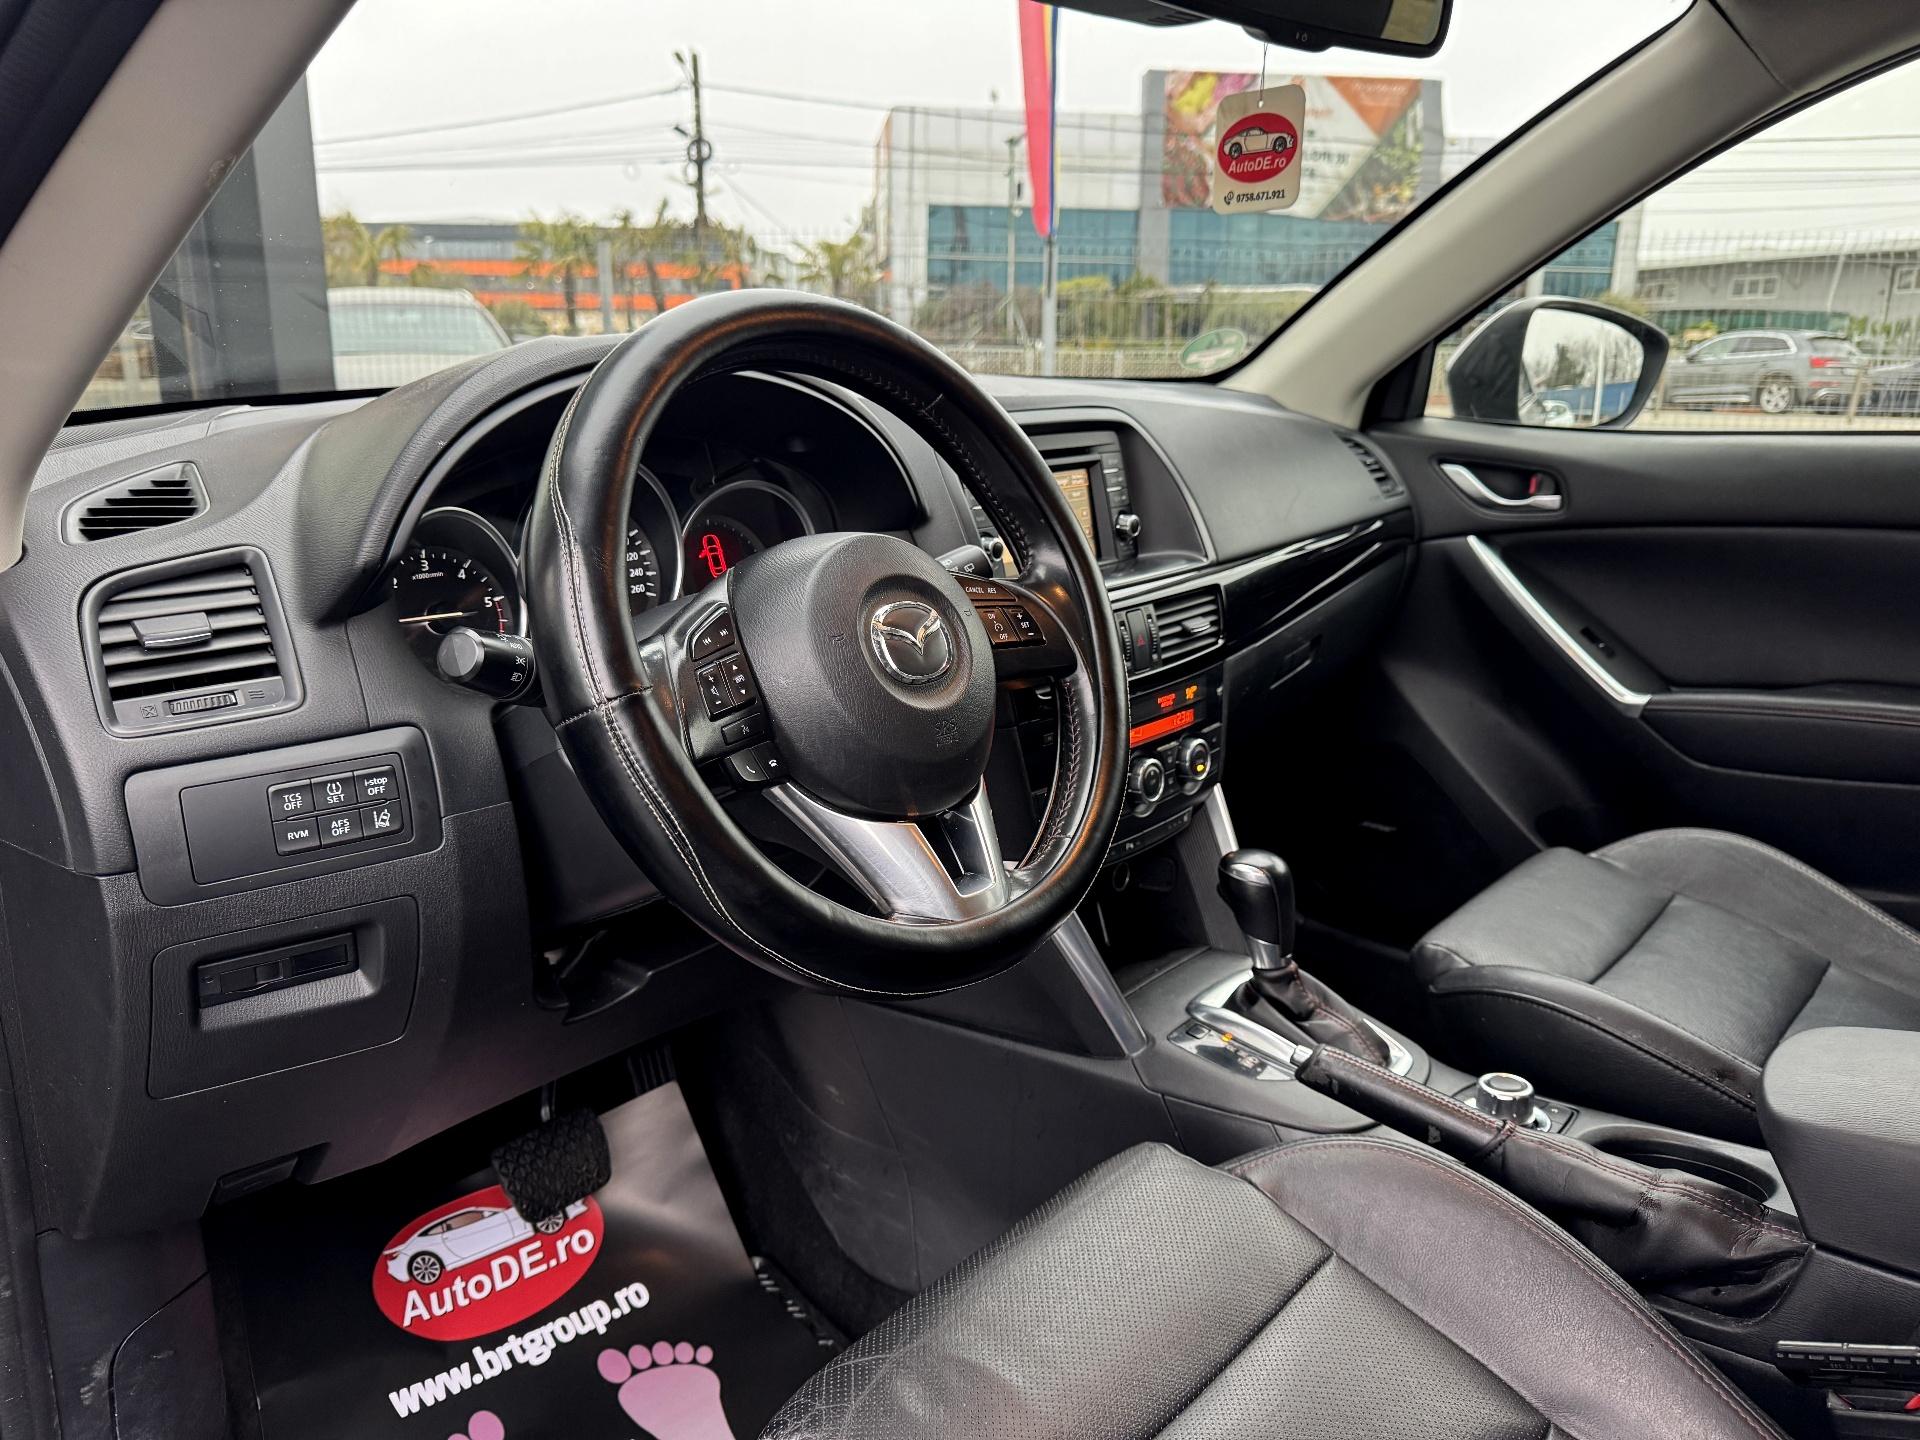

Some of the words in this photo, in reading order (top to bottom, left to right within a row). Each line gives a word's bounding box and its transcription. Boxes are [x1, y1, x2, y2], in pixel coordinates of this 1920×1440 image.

[1228, 154, 1287, 174] AutoDE.ro
[1235, 189, 1285, 204] 0758.671.921
[420, 560, 429, 571] 3
[457, 569, 466, 580] 4
[629, 567, 644, 578] 240
[630, 583, 646, 594] 260
[965, 586, 984, 594] CANCEL
[484, 596, 493, 608] 5
[364, 776, 388, 787] i-stop
[367, 785, 386, 796] OFF
[283, 792, 302, 803] TCS
[326, 793, 345, 804] SET
[284, 800, 303, 811] OFF
[331, 818, 350, 829] AFS
[287, 829, 309, 841] RVM
[332, 826, 351, 837] OFF
[402, 1228, 596, 1328] AutoDE.ro
[388, 1282, 650, 1418] www.brtgroup.ro
